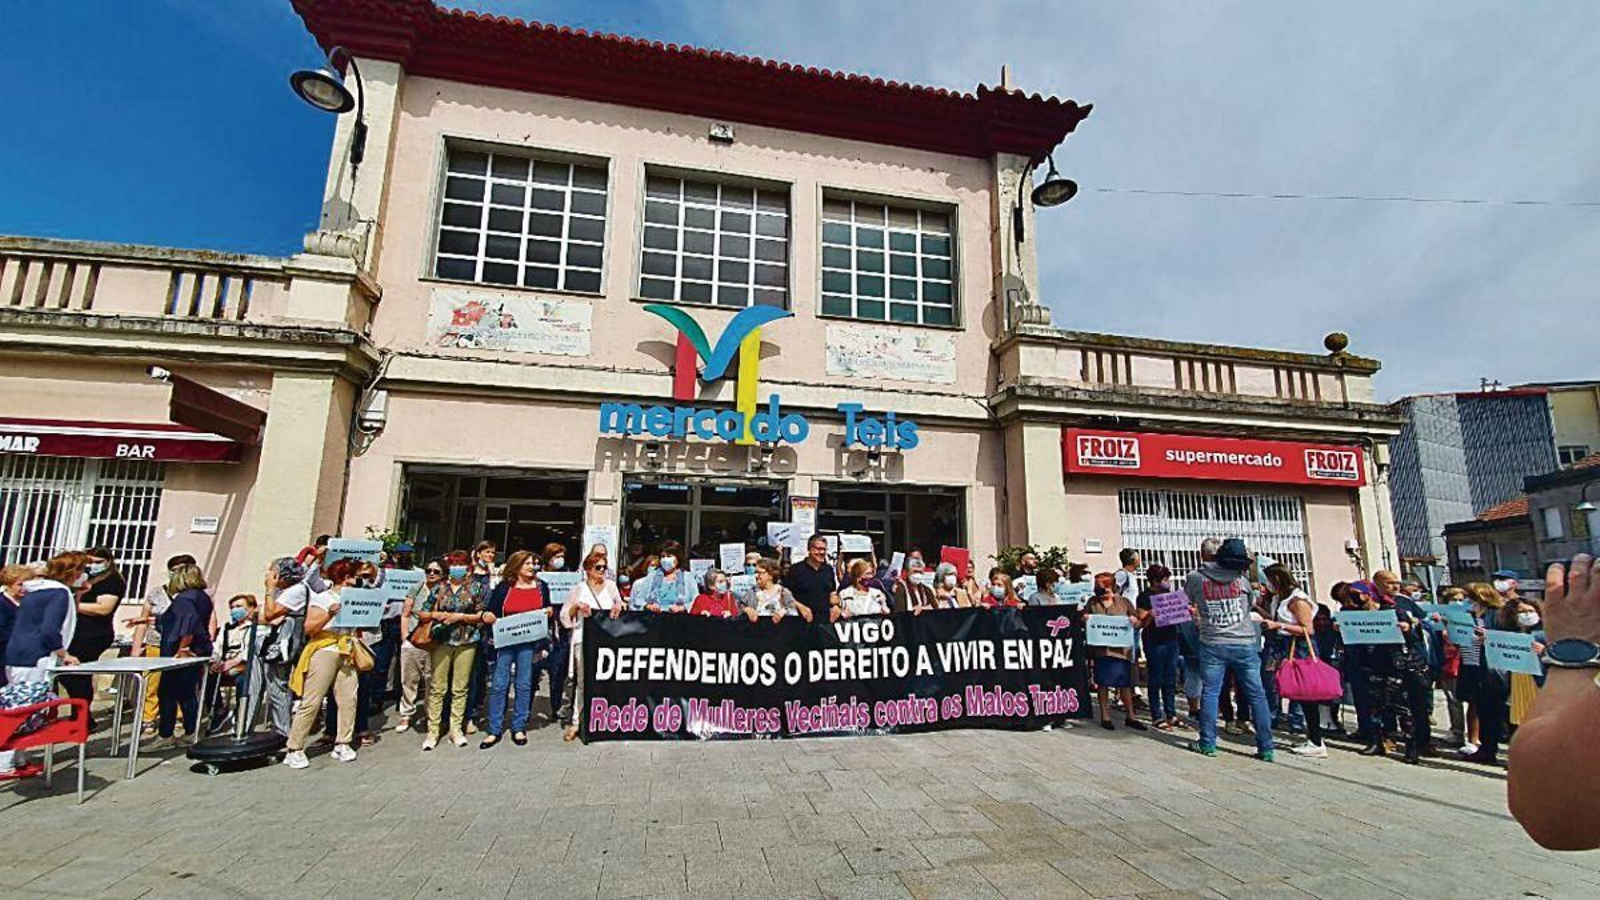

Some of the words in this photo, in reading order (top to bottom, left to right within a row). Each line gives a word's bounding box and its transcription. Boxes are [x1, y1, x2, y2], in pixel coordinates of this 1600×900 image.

[600, 395, 808, 445] mercado
[838, 401, 919, 450] Teis
[115, 444, 156, 458] BAR
[1080, 438, 1136, 459] FROIZ
[1165, 449, 1283, 467] supermercado
[1307, 451, 1355, 471] FROIZ
[834, 619, 895, 644] VIGO
[595, 647, 777, 687] DEFENDEMOS
[784, 651, 802, 685] O
[808, 646, 911, 683] DEREITO
[915, 644, 934, 676] A
[936, 640, 997, 673] VIVIR
[1003, 639, 1033, 670] EN
[1039, 638, 1074, 669] PAZ
[589, 697, 649, 733] Rede
[652, 697, 683, 733] de
[687, 697, 781, 734] Mulleres
[785, 695, 870, 734] Veciñais
[874, 693, 938, 727] contra
[941, 693, 963, 721] os
[965, 684, 1029, 718] Malos
[1028, 684, 1080, 717] Tratos
